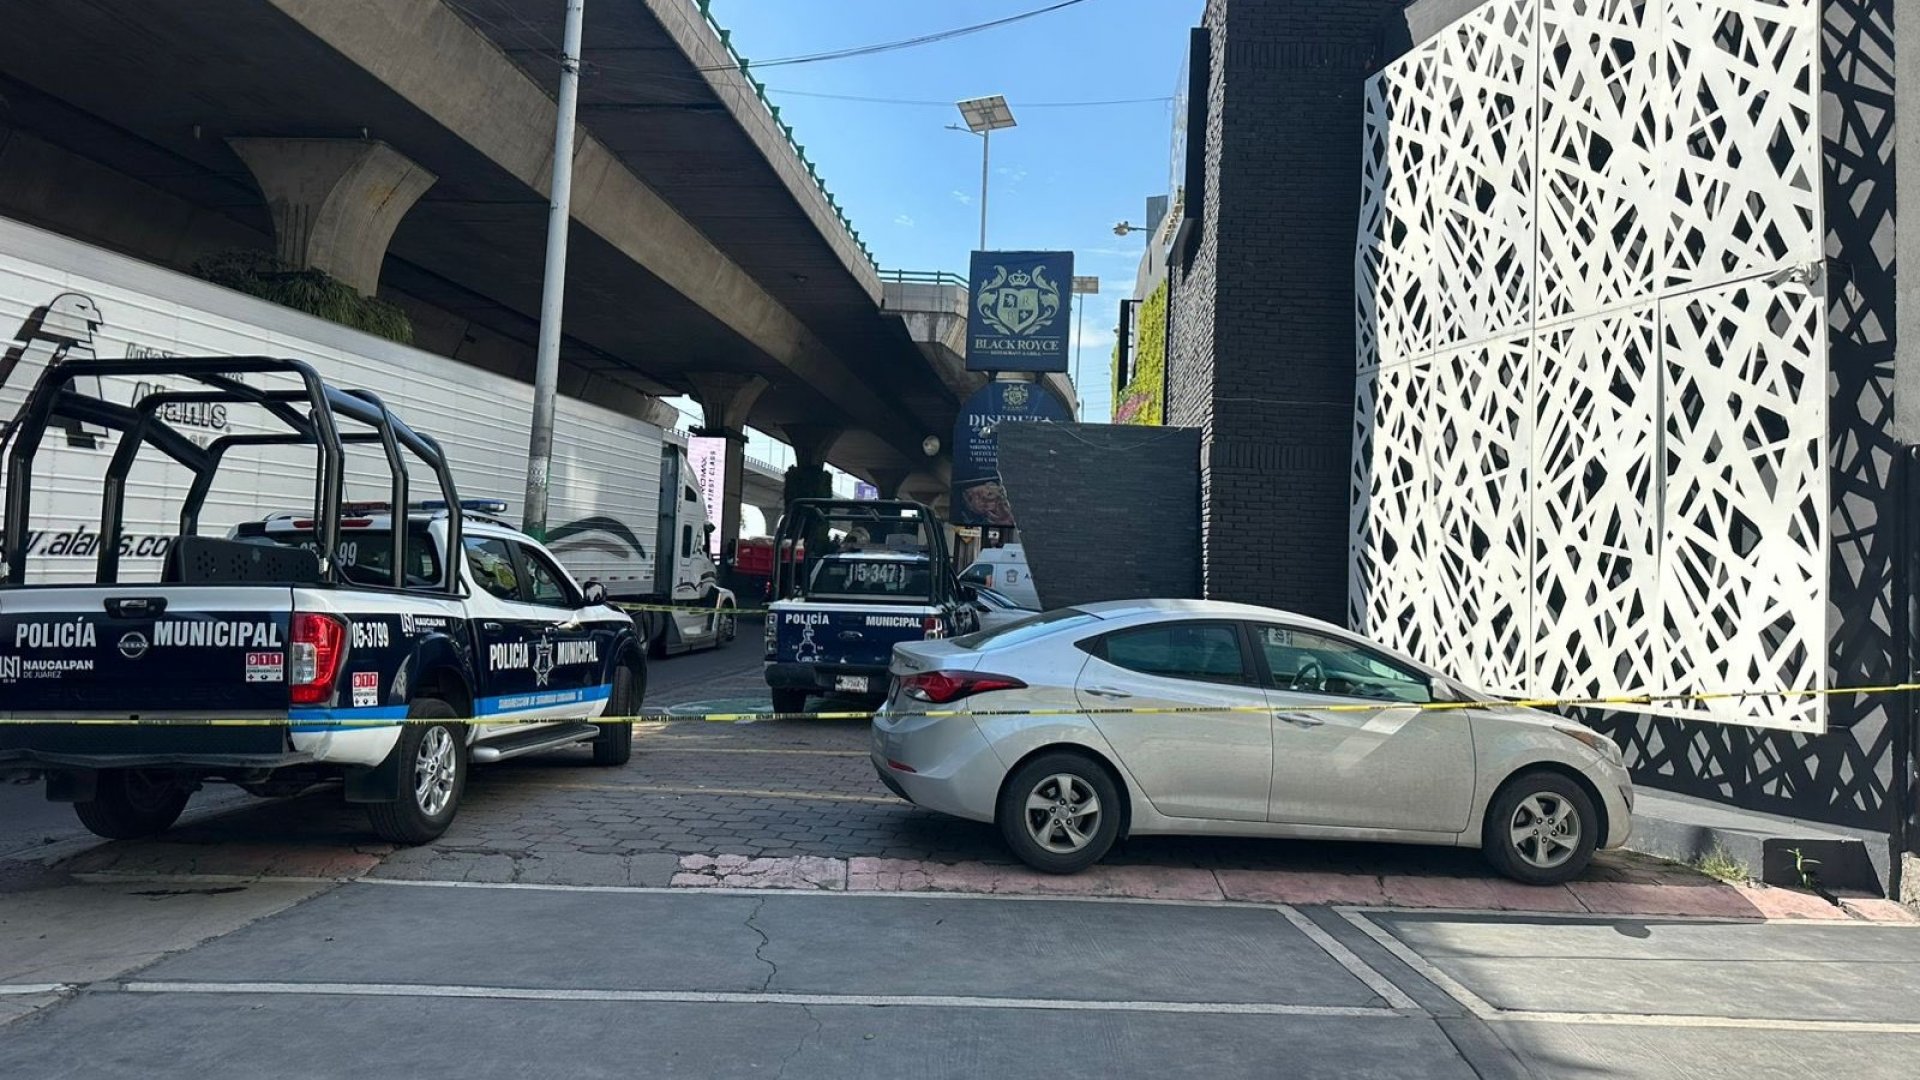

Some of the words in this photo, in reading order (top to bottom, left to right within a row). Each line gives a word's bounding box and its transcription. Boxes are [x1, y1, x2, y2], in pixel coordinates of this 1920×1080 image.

[785, 612, 830, 625] POLICÍA
[866, 616, 922, 628] MUNICIPAL
[15, 616, 97, 648] POLICÍA
[153, 621, 282, 648] MUNICIPAL
[352, 622, 389, 648] 05-3799
[249, 654, 279, 665] 911
[489, 636, 529, 671] POLICÍA
[557, 640, 599, 666] MUNICIPAL
[23, 660, 94, 670] NAUCALPAN
[354, 675, 376, 687] 911
